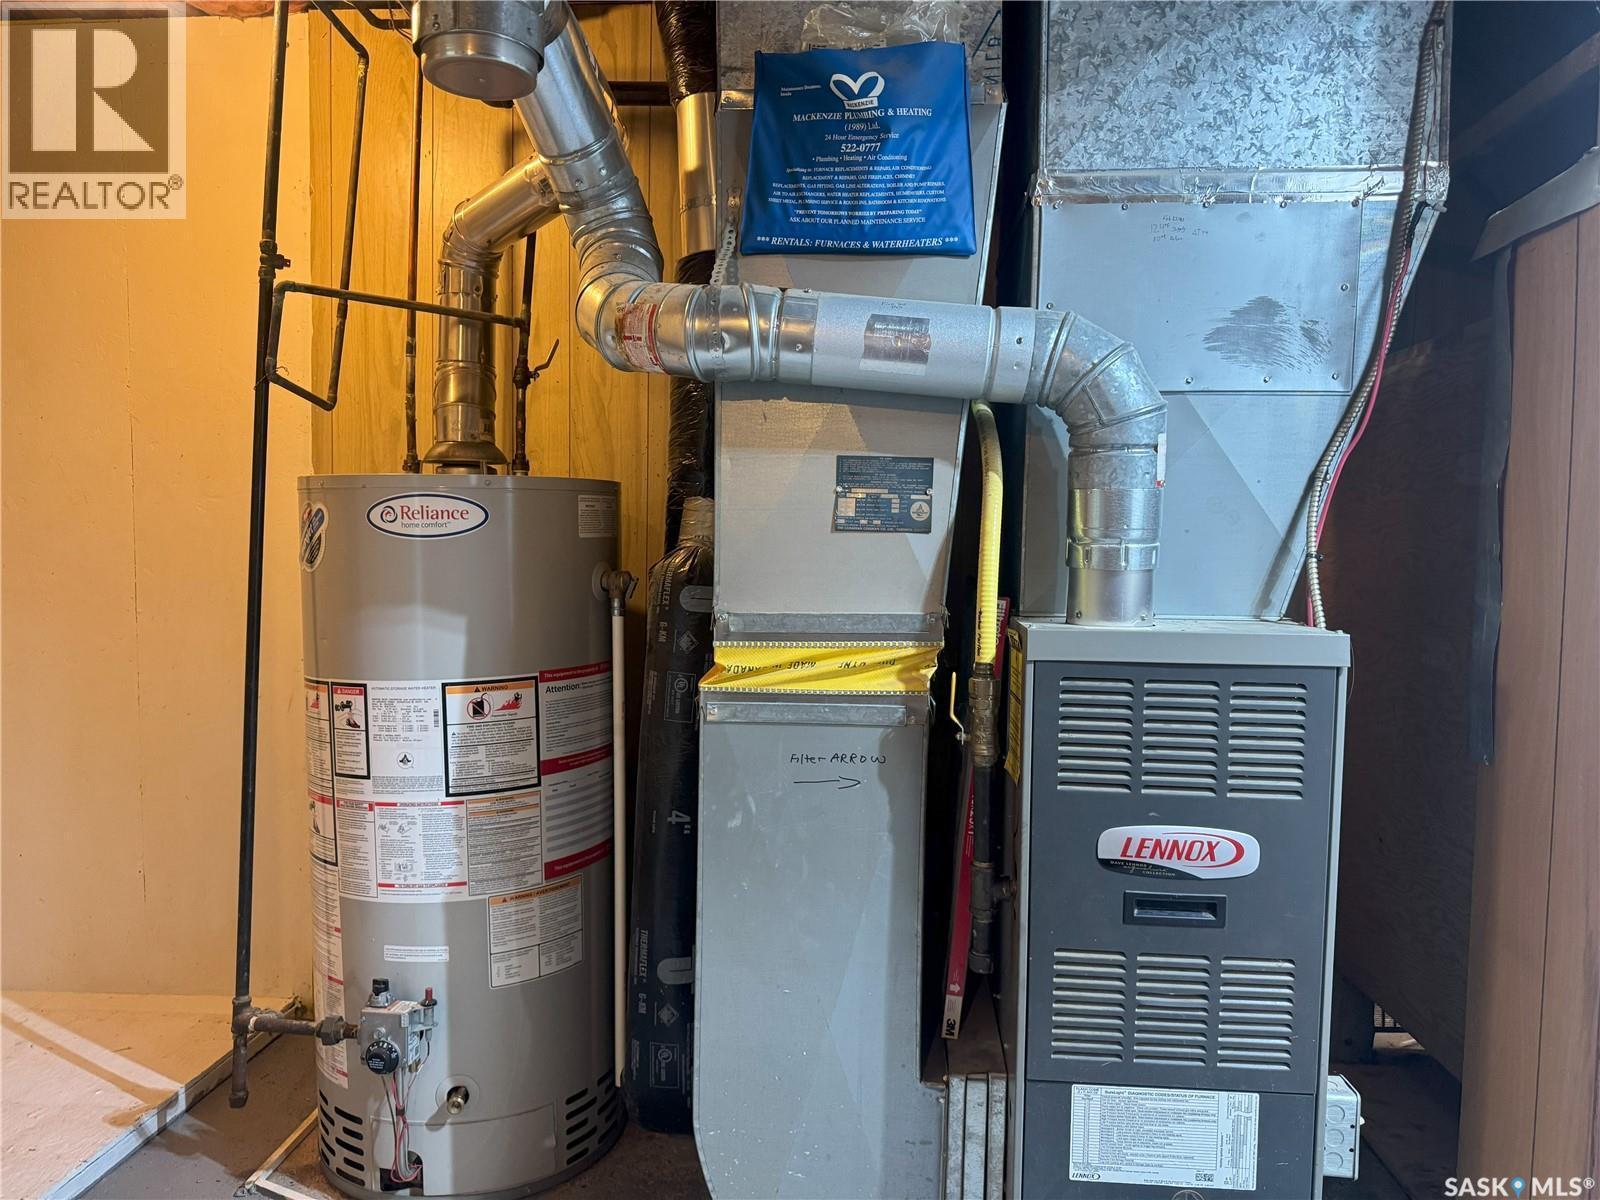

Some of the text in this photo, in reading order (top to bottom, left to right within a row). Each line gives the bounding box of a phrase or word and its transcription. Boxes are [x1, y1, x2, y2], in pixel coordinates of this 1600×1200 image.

[793, 112, 842, 122] MACKENZIE
[844, 108, 885, 120] PLUMBING
[896, 108, 932, 117] HEATING
[844, 121, 880, 132] (1989) Ltd.
[847, 133, 878, 142] Emergency
[880, 132, 899, 140] Service
[840, 142, 881, 153] 522-0777
[815, 155, 839, 163] Plumbing
[860, 217, 903, 225] MAINTENANCE
[771, 236, 813, 247] RENTALS:
[815, 239, 861, 249] FURNACES
[862, 240, 870, 249] &
[872, 237, 943, 249] WATERHEATERS
[400, 505, 470, 521] Reliance
[830, 753, 887, 764] ARROW
[1120, 837, 1220, 862] LENNOX
[945, 1018, 957, 1036] 3M
